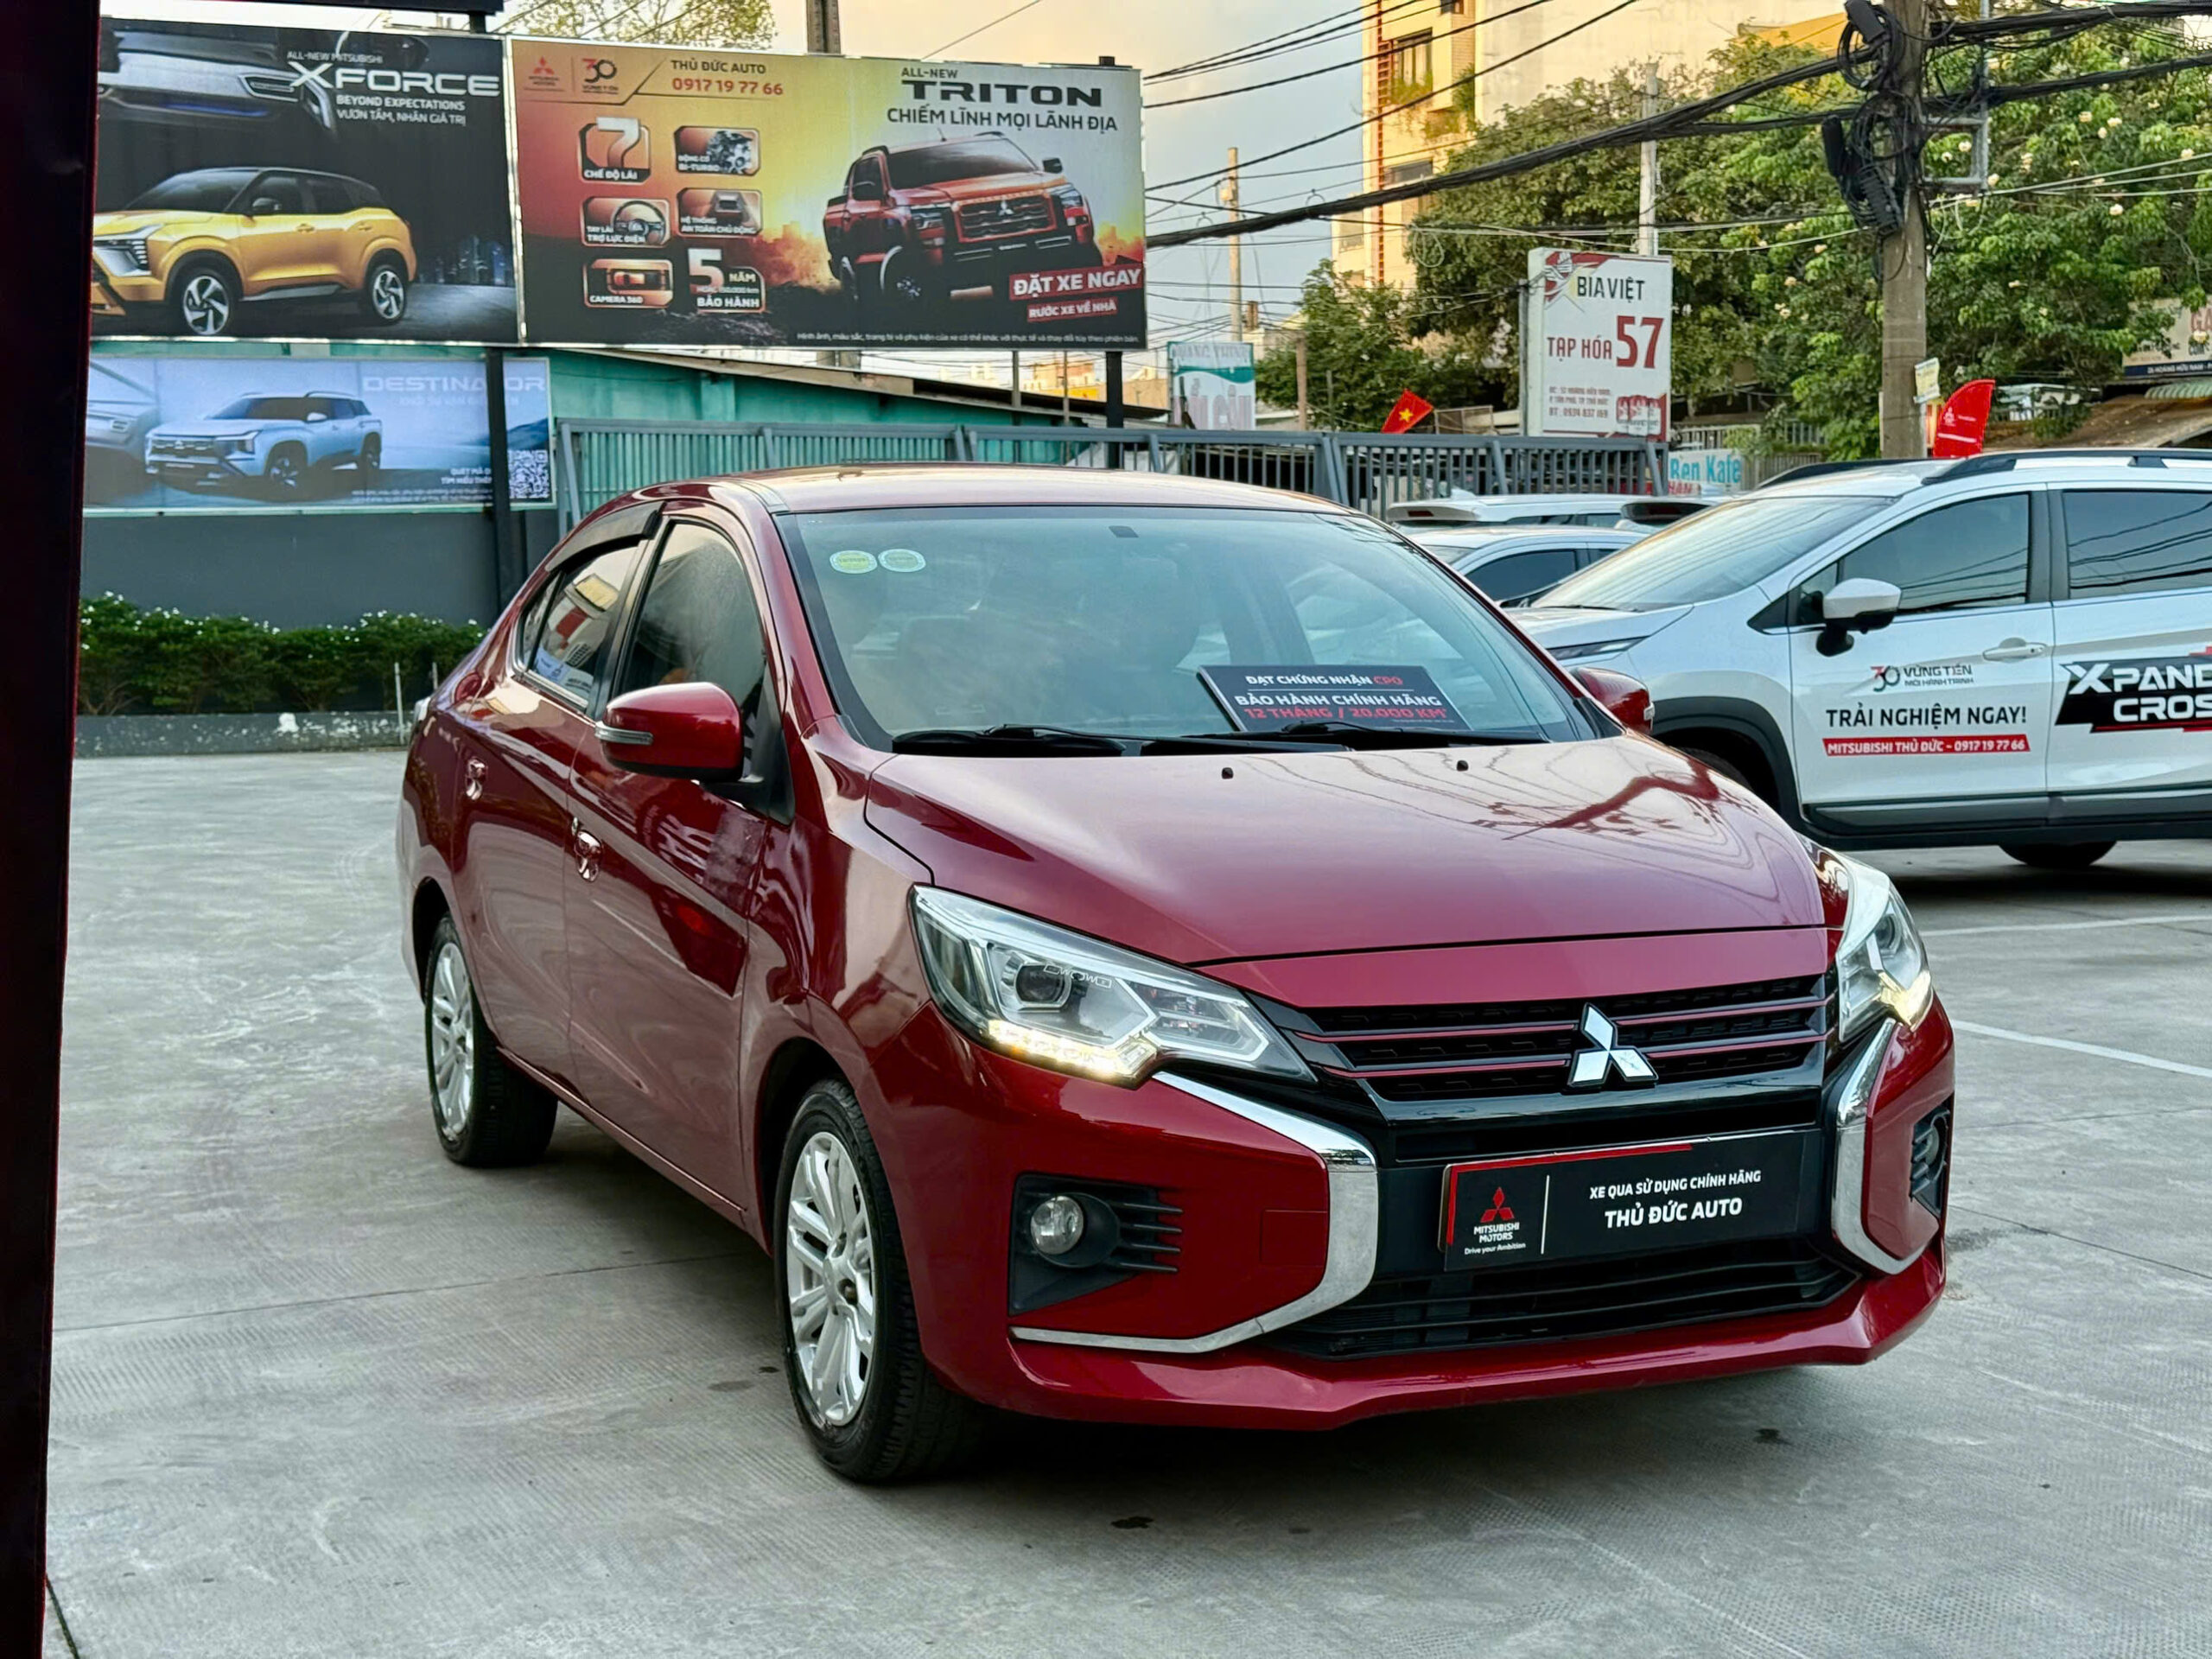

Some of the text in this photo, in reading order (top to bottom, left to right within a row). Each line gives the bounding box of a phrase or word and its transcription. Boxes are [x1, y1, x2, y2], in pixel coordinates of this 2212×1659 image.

[286, 51, 383, 63] ALL-NEW MITSUBISHI
[671, 57, 766, 74] THỦ ĐỨC AUTO
[901, 67, 958, 79] ALL-NEW
[672, 78, 783, 95] 0917 19 77 66
[901, 79, 1103, 107] TRITON
[336, 94, 466, 111] BEYOND EXPECTATIONS
[337, 109, 368, 120] VƯƠN
[887, 104, 1118, 134] CHIẾM LĨNH MỌI LÃNH ĐỊA
[596, 117, 640, 168] 7
[583, 168, 638, 181] CHẾ ĐỘ LÁI
[688, 248, 756, 295] 5 NĂM
[1013, 269, 1141, 298] ĐẶT XE NGAY
[1577, 276, 1645, 303] BIA VIỆT
[590, 295, 643, 304] CAMERA 360
[696, 294, 760, 308] BẢO HÀNH
[1028, 300, 1116, 318] RƯỚC XE VỀ NHÀ
[1547, 315, 1664, 369] TẠP HÓA 57
[362, 376, 545, 391] DESTINAOR
[1870, 664, 1900, 692] 30
[1942, 664, 1973, 677] TIẾN
[1245, 674, 1403, 686] ĐẠT CHỨNG NHẬN CPO
[1234, 692, 1442, 706] BẢO HÀNH CHÍNH HÃNG
[1244, 708, 1267, 719] 12
[1267, 705, 1332, 718] THÁNG
[1349, 708, 1414, 718] 20.000
[1826, 702, 2026, 729] TRẢI NGHIỆM NGAY!
[1827, 742, 1893, 754] MITSUBISHI
[1895, 738, 1917, 753] THỦ
[1921, 739, 1944, 753] ĐỨC
[1955, 741, 1980, 752] 0917
[1981, 740, 1994, 751] 19
[1996, 740, 2009, 751] 77
[2011, 739, 2025, 750] 66
[1589, 1186, 1605, 1199] XE
[1608, 1183, 1633, 1199] QUA
[1654, 1179, 1688, 1194] DỤNG
[1690, 1173, 1726, 1190] CHÍNH
[1728, 1169, 1762, 1185] HÃNG
[1605, 1198, 1743, 1229] THỦ ĐỨC AUTO
[1473, 1222, 1520, 1236] MITSUBISHI
[1479, 1231, 1513, 1243] MOTORS
[1465, 1243, 1527, 1255] Drive your Ambition
